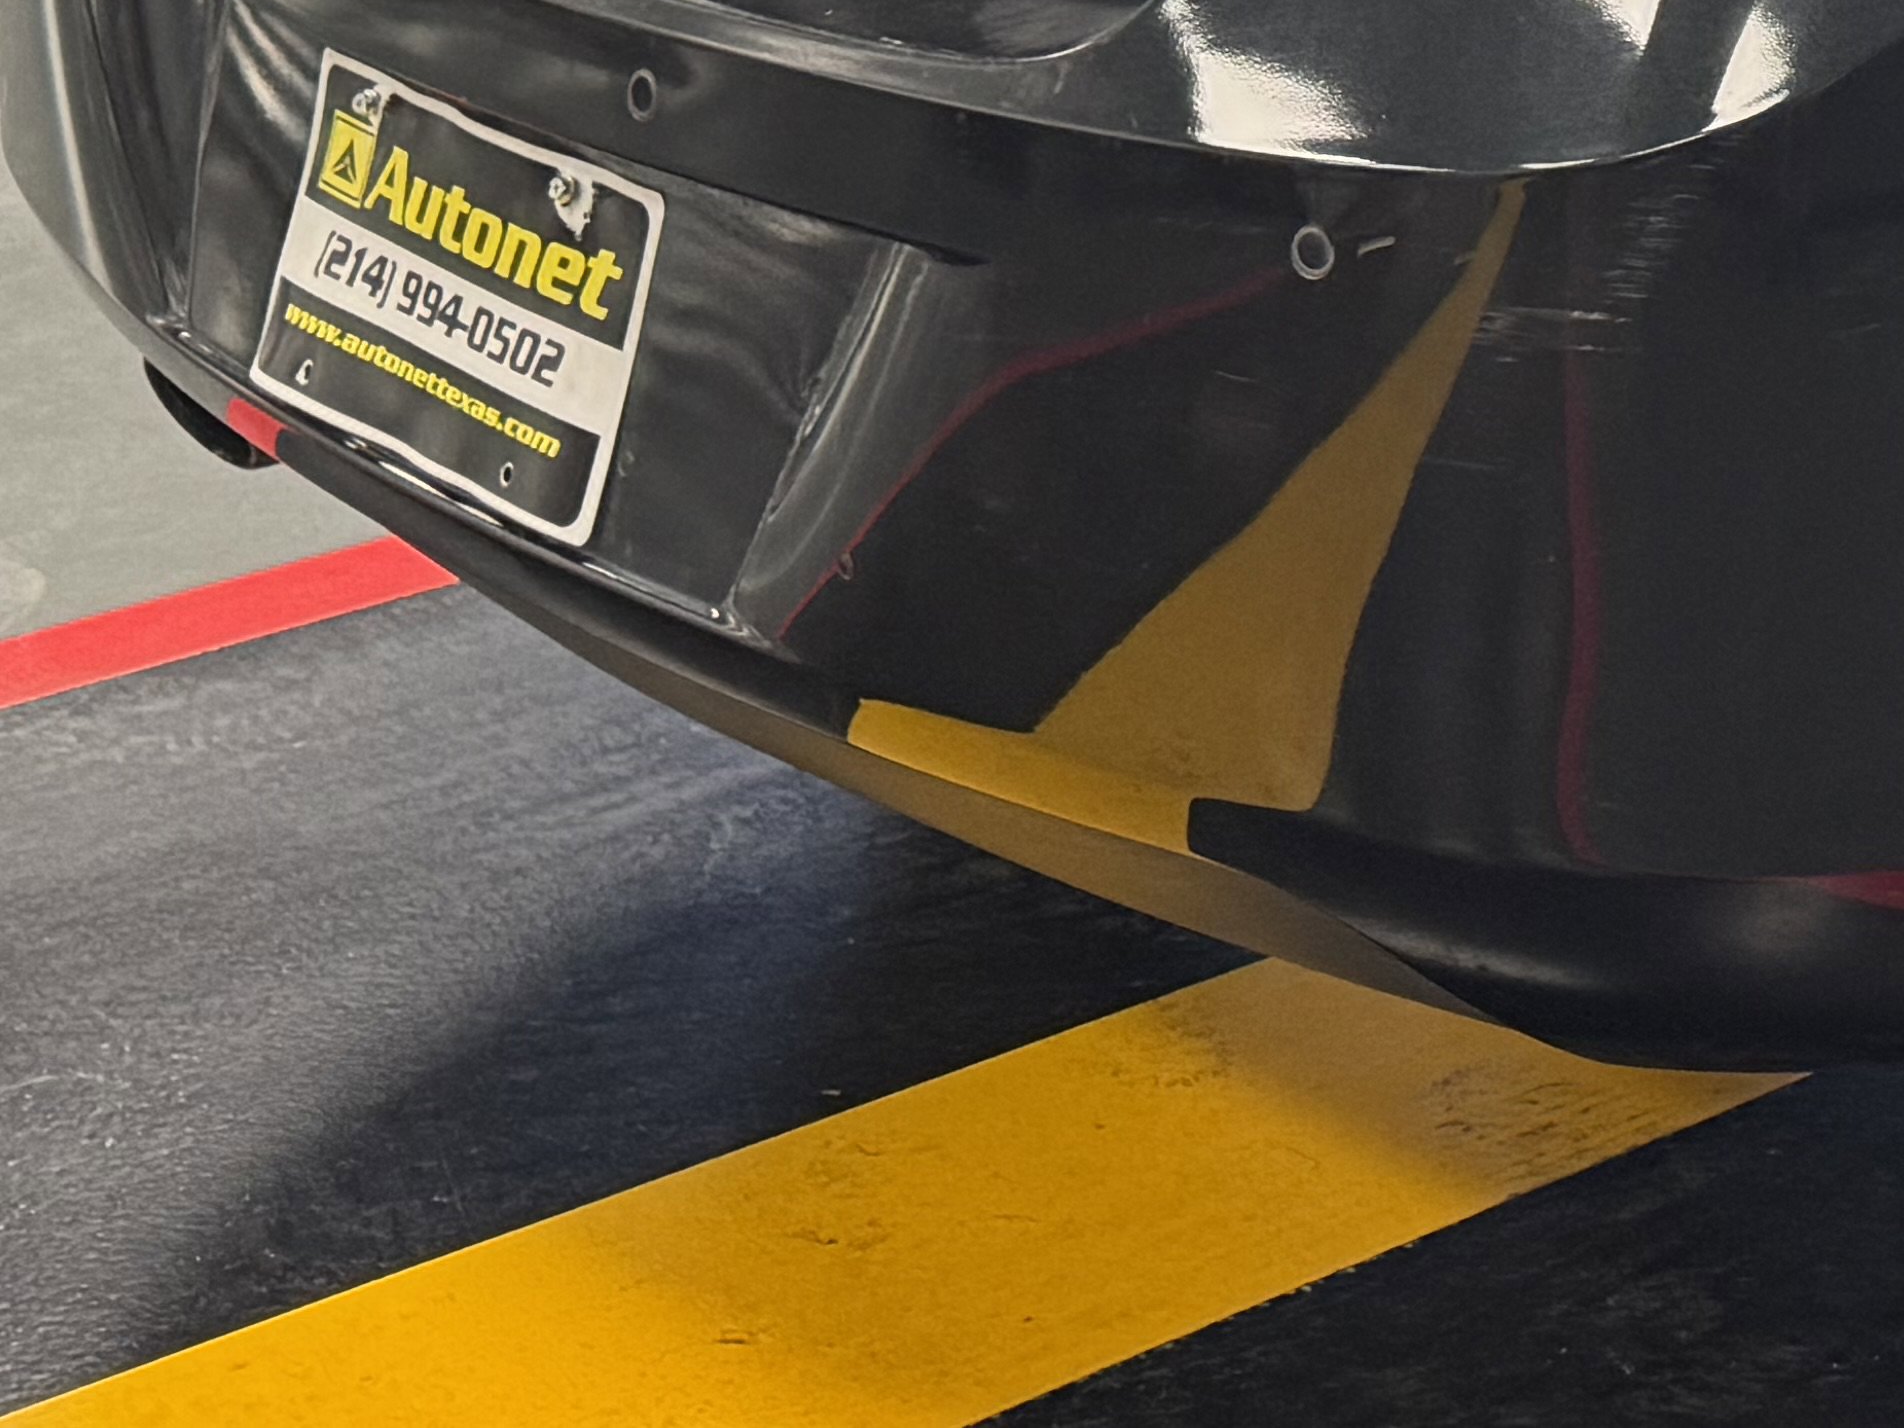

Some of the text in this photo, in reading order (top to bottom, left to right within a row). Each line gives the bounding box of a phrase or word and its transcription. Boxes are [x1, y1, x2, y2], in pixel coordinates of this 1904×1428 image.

[315, 230, 566, 387] (214) 994-0502
[363, 145, 624, 321] Autonet
[285, 302, 561, 458] www.autonettexas.com
